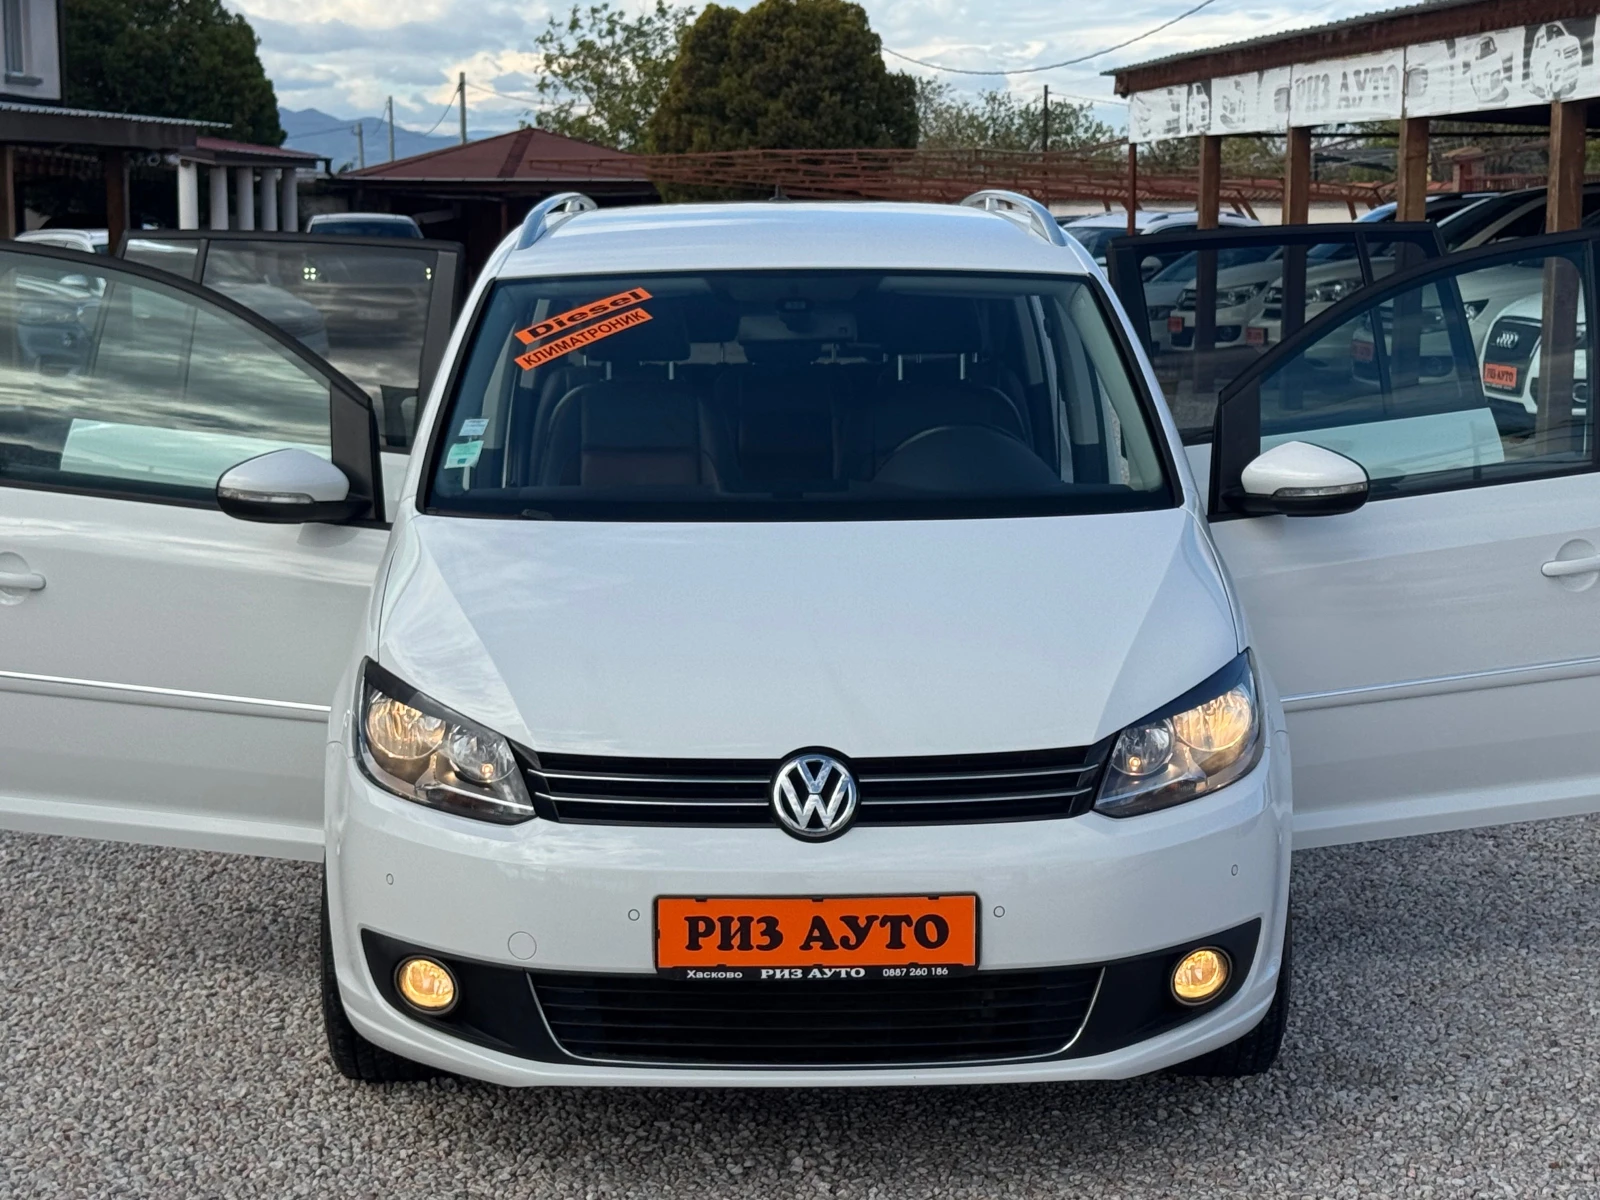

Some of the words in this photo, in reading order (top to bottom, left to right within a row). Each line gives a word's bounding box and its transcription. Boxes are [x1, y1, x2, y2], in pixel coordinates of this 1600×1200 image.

[526, 291, 644, 339] Diesel
[522, 310, 646, 367] КЛИМАТРОНИК
[684, 914, 784, 951] РИЗ
[798, 914, 950, 951] АУТО
[686, 969, 743, 979] Хасково
[760, 968, 803, 979] РИЗ
[807, 967, 866, 979] АУТО
[882, 968, 907, 977] 0887
[909, 967, 928, 976] 260
[931, 967, 949, 975] 186
